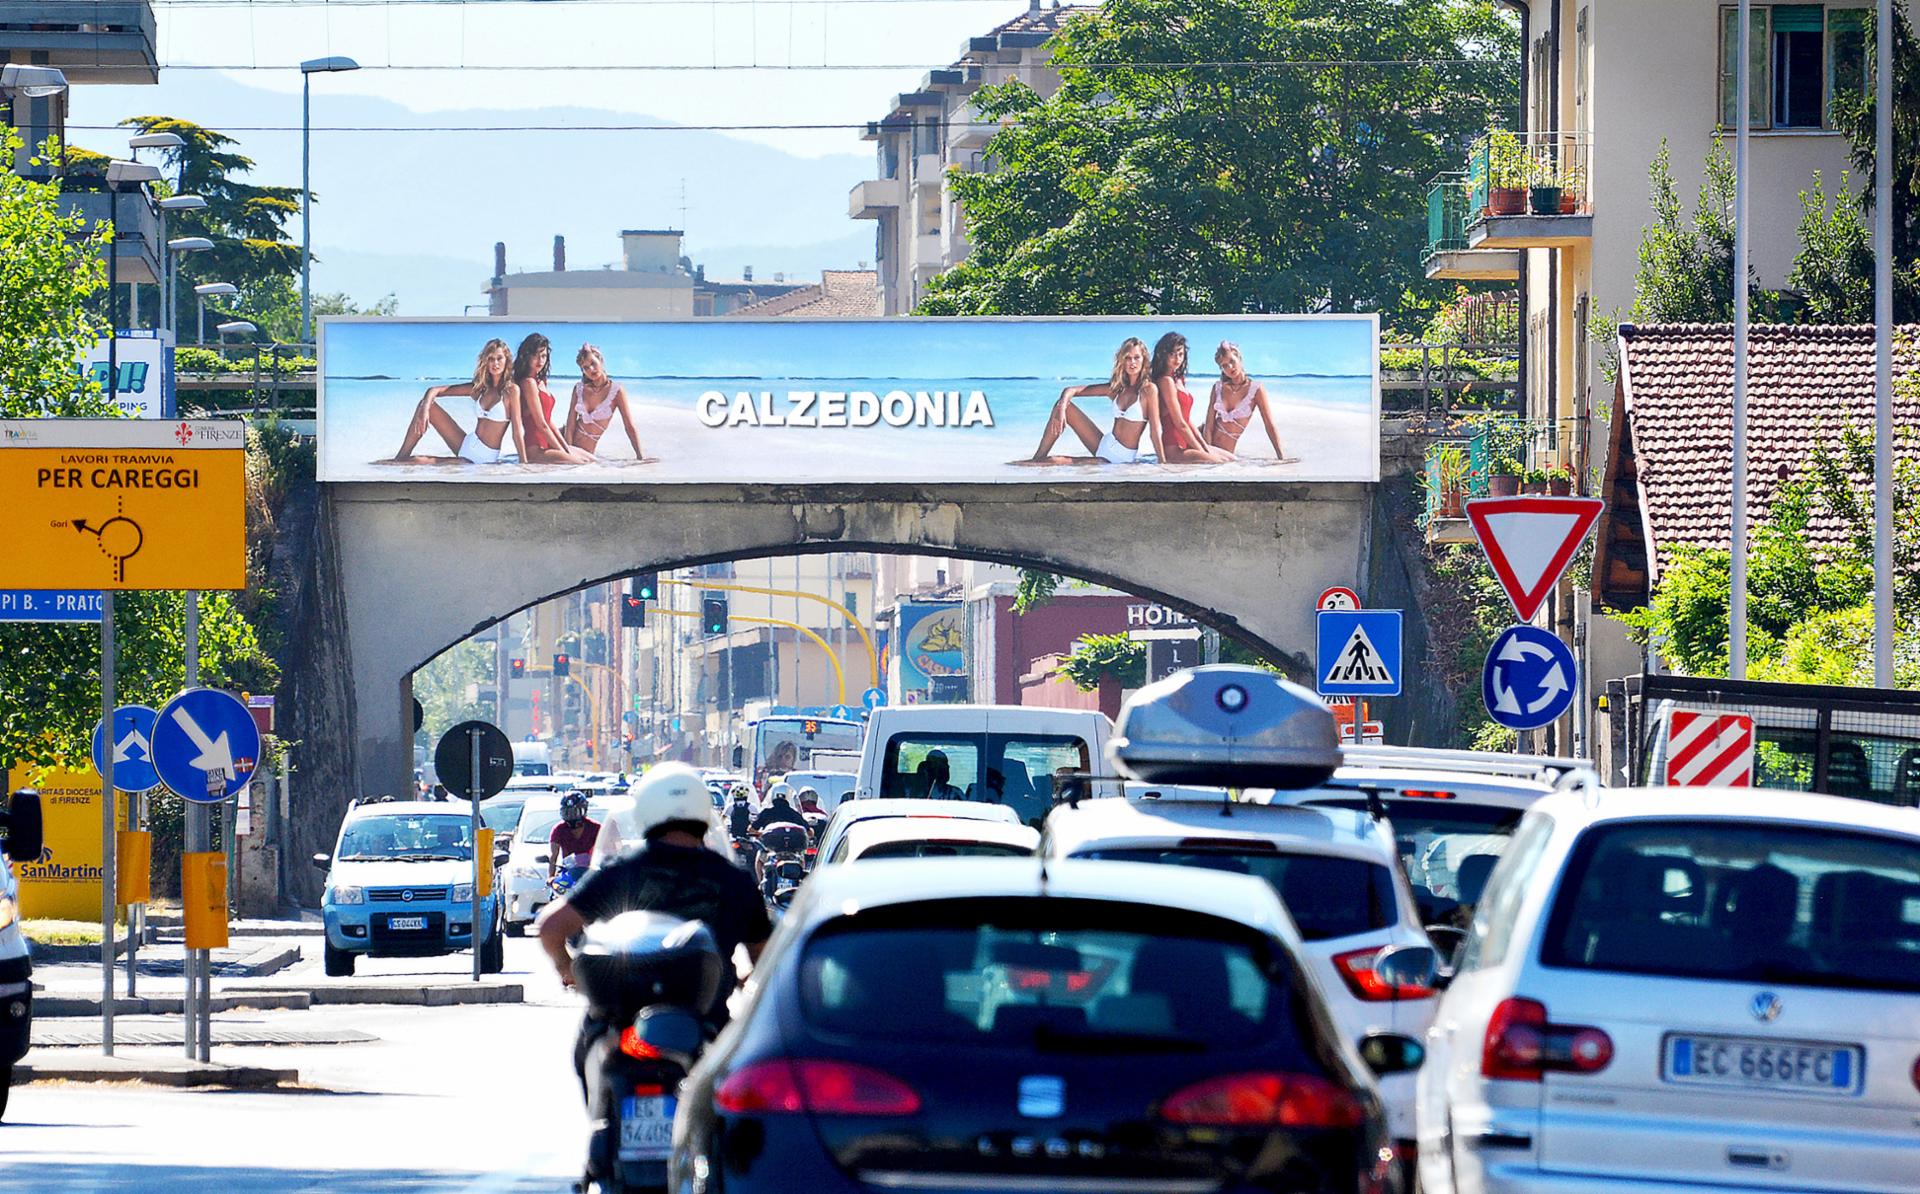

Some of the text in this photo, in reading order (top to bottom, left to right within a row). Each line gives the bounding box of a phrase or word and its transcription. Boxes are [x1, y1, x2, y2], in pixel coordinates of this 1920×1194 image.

[696, 390, 995, 428] CALZEDONIA
[200, 430, 242, 441] FIRENZE
[61, 455, 174, 464] LAVORI TRAMVIA
[37, 468, 199, 488] PER CAREGGI
[50, 519, 68, 528] Gori
[23, 594, 38, 610] B.
[805, 721, 817, 733] 35
[1694, 1042, 1831, 1083] EC 666FC
